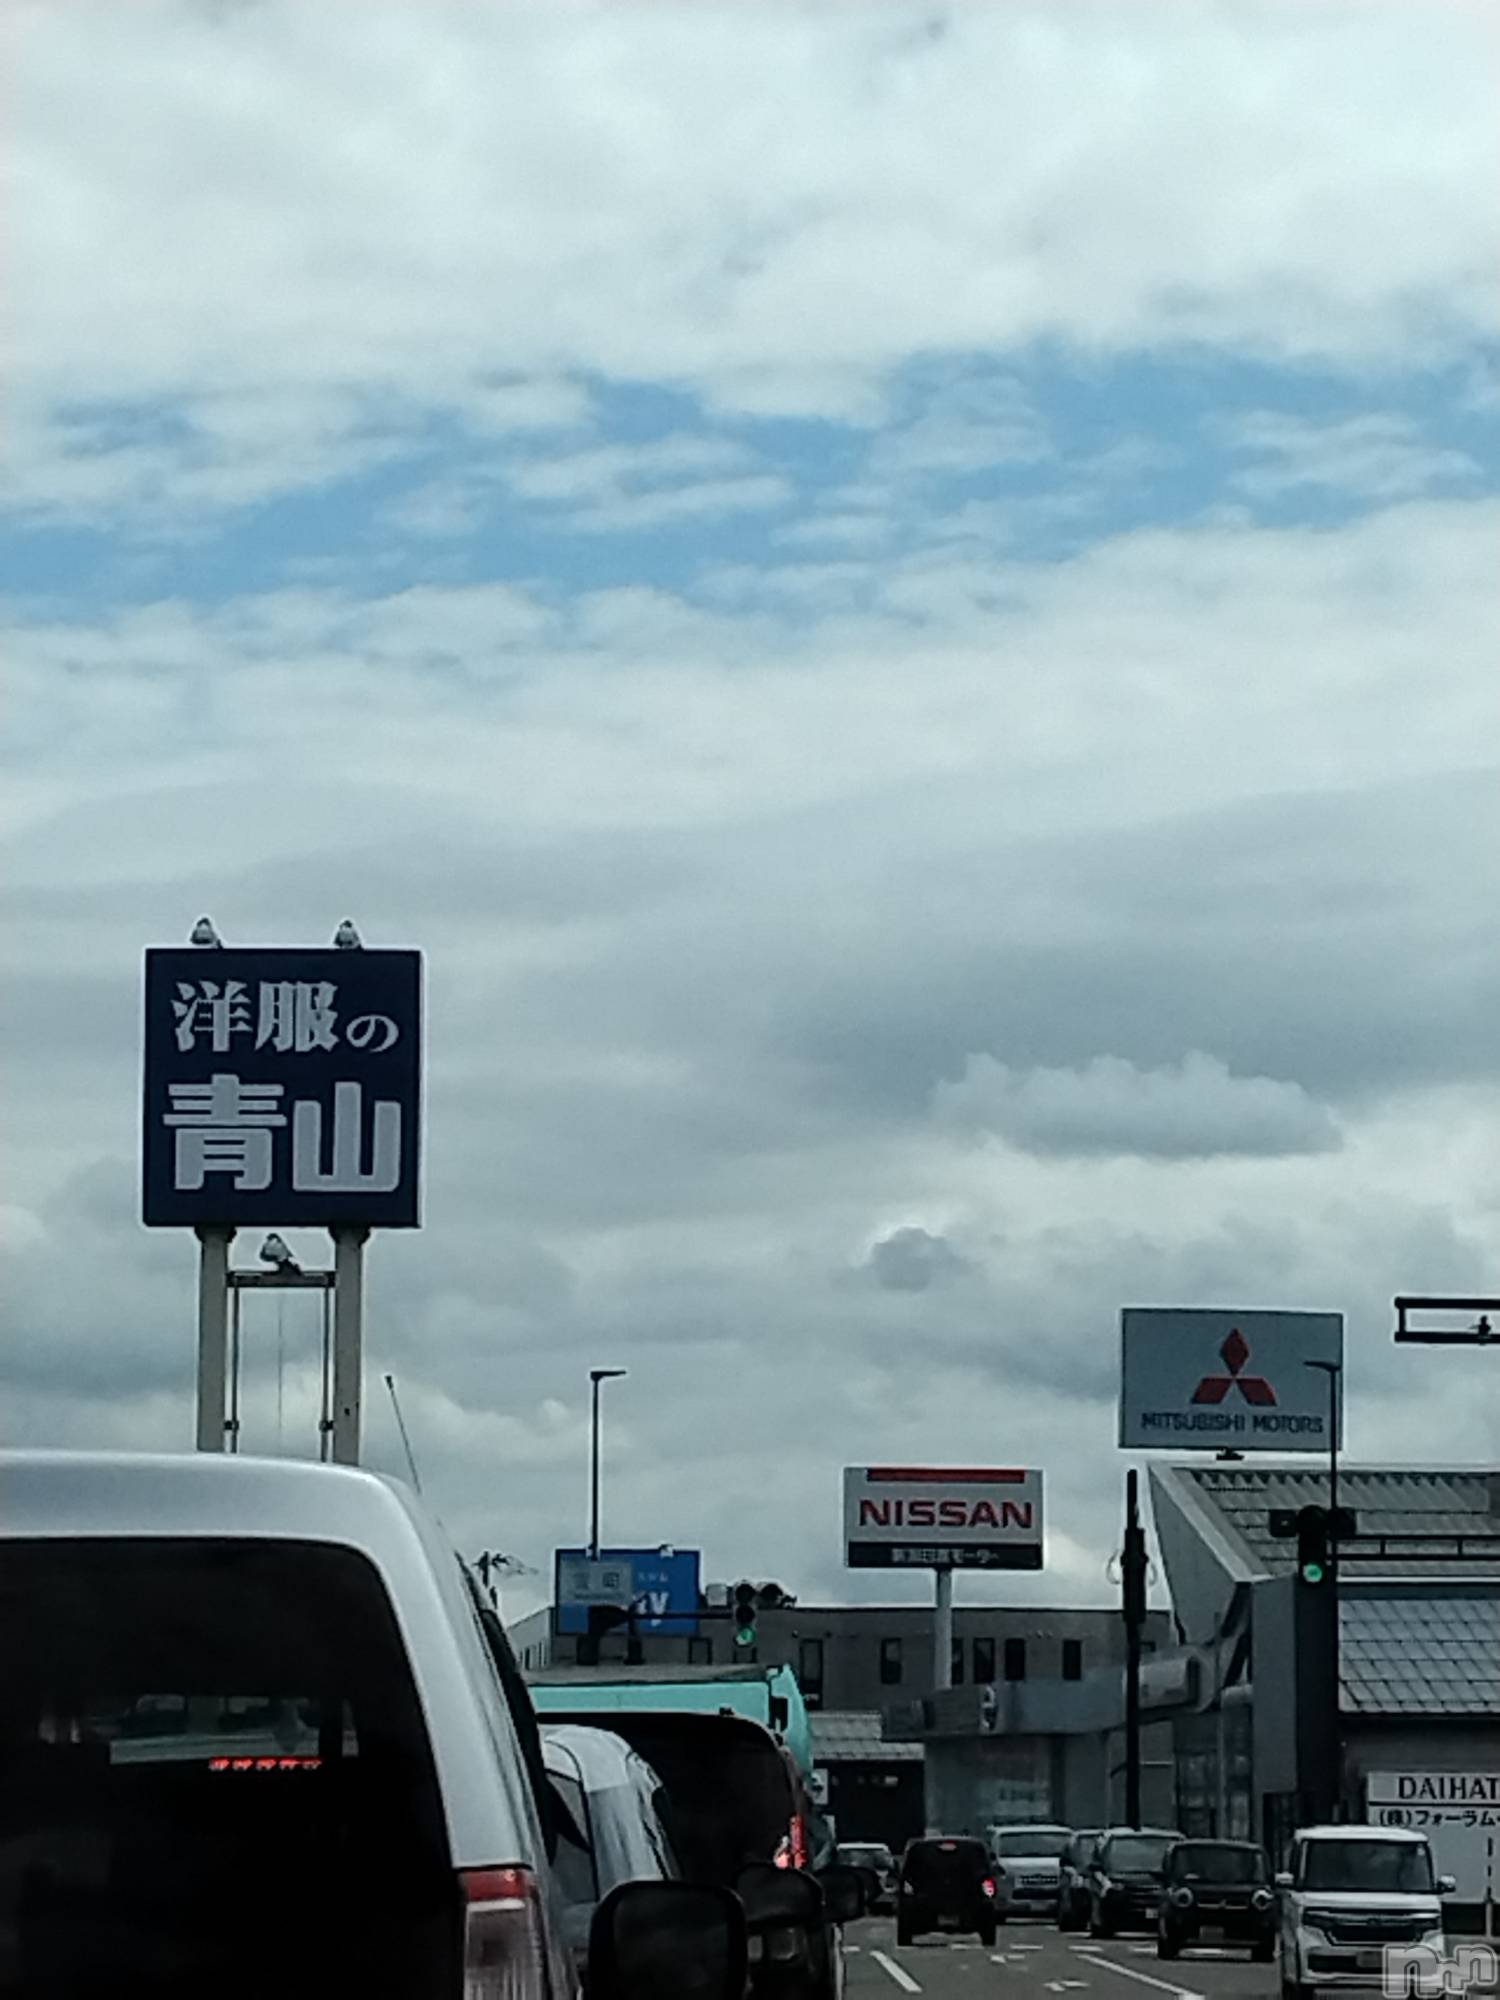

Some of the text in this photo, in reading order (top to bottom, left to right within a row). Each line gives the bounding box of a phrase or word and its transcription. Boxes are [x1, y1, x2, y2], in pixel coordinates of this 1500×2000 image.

[171, 980, 400, 1052] 洋服の
[162, 1073, 402, 1192] 青山
[1140, 1412, 1324, 1433] MITSUBISHI MOTORS
[859, 1499, 1032, 1528] NISSAN
